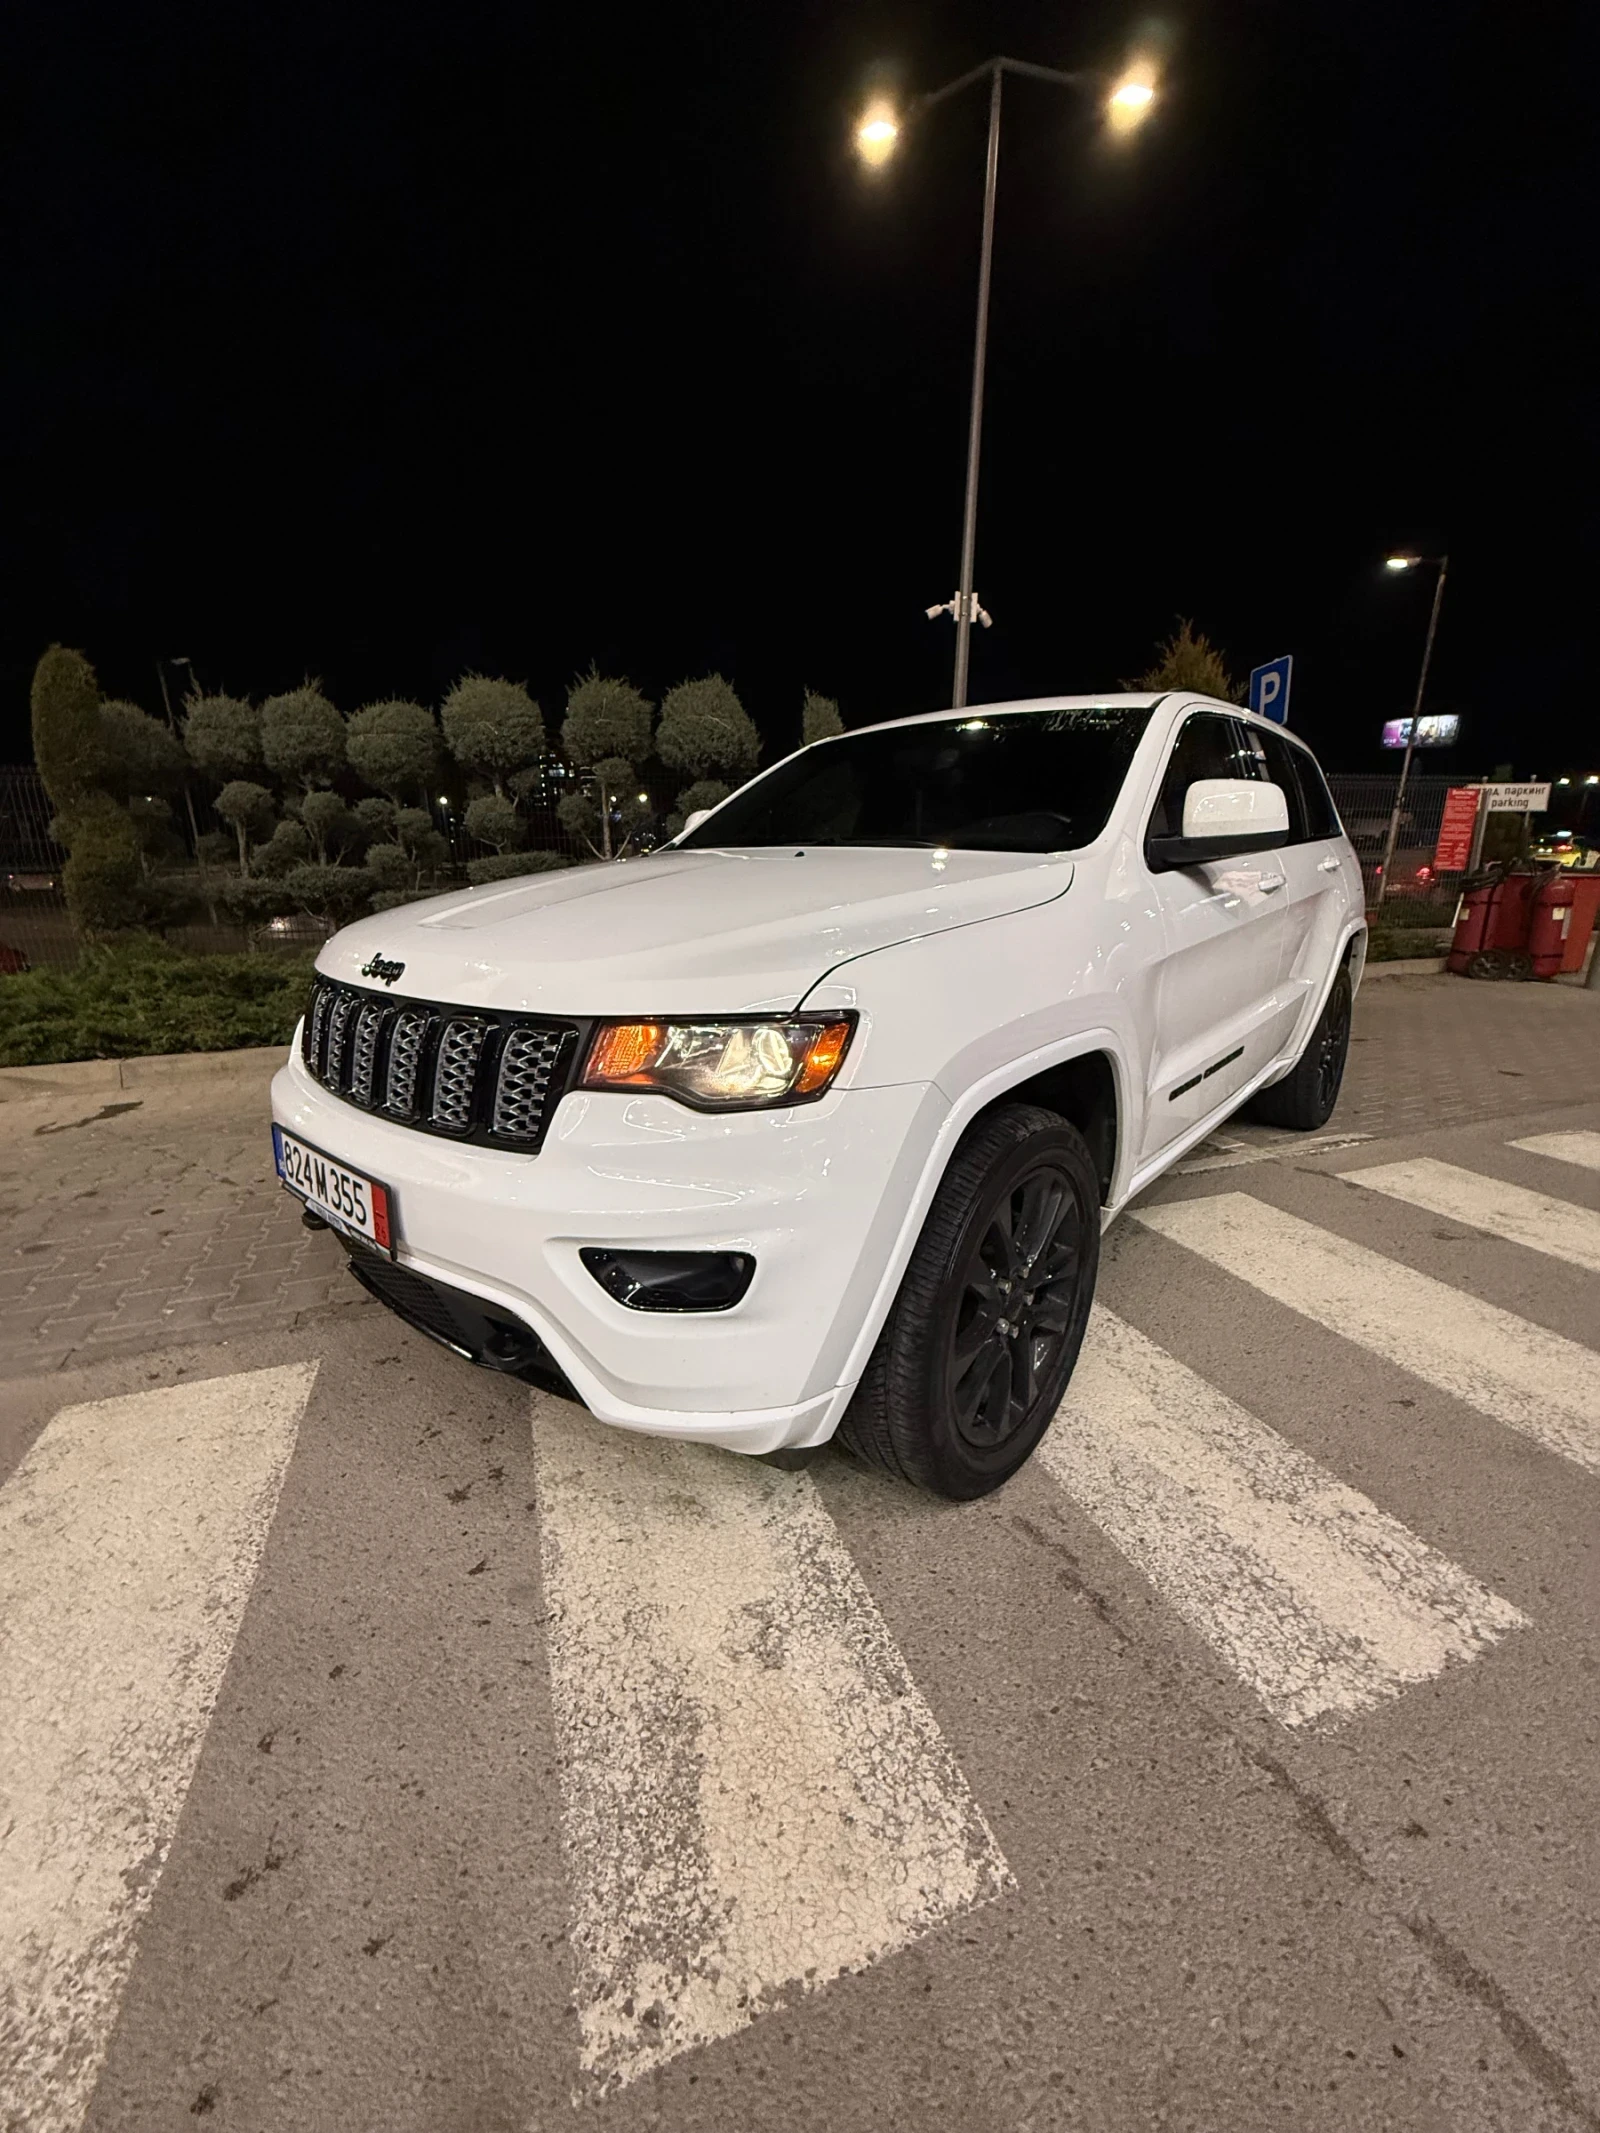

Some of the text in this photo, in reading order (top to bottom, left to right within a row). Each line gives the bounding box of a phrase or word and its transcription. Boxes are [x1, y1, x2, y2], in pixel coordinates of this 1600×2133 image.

[1259, 671, 1280, 717] P
[1492, 798, 1529, 808] parking
[1504, 787, 1546, 797] паркинг
[361, 952, 406, 987] Jeep
